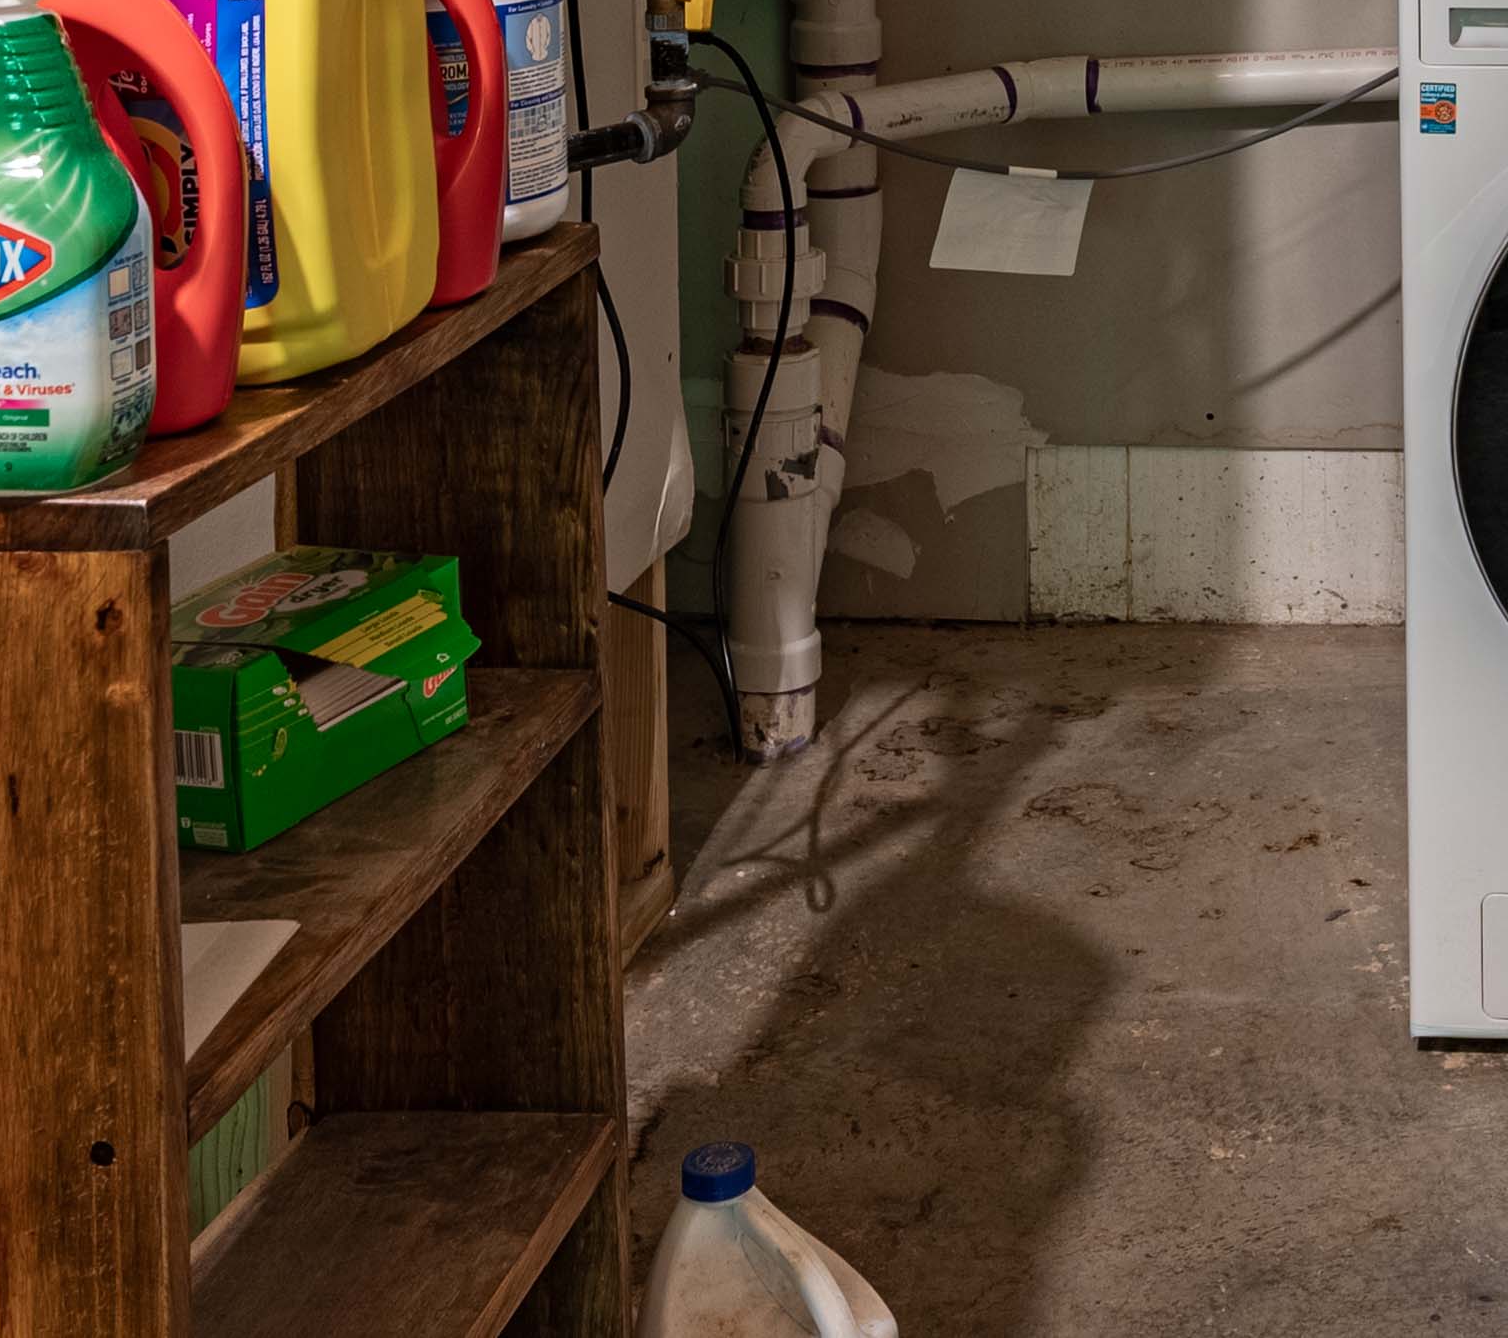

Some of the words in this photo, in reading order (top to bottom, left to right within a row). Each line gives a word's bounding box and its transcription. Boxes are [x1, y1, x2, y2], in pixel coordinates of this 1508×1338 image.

[1421, 84, 1456, 92] CERTIFIED
[4, 384, 13, 395] &
[196, 572, 315, 628] Gain
